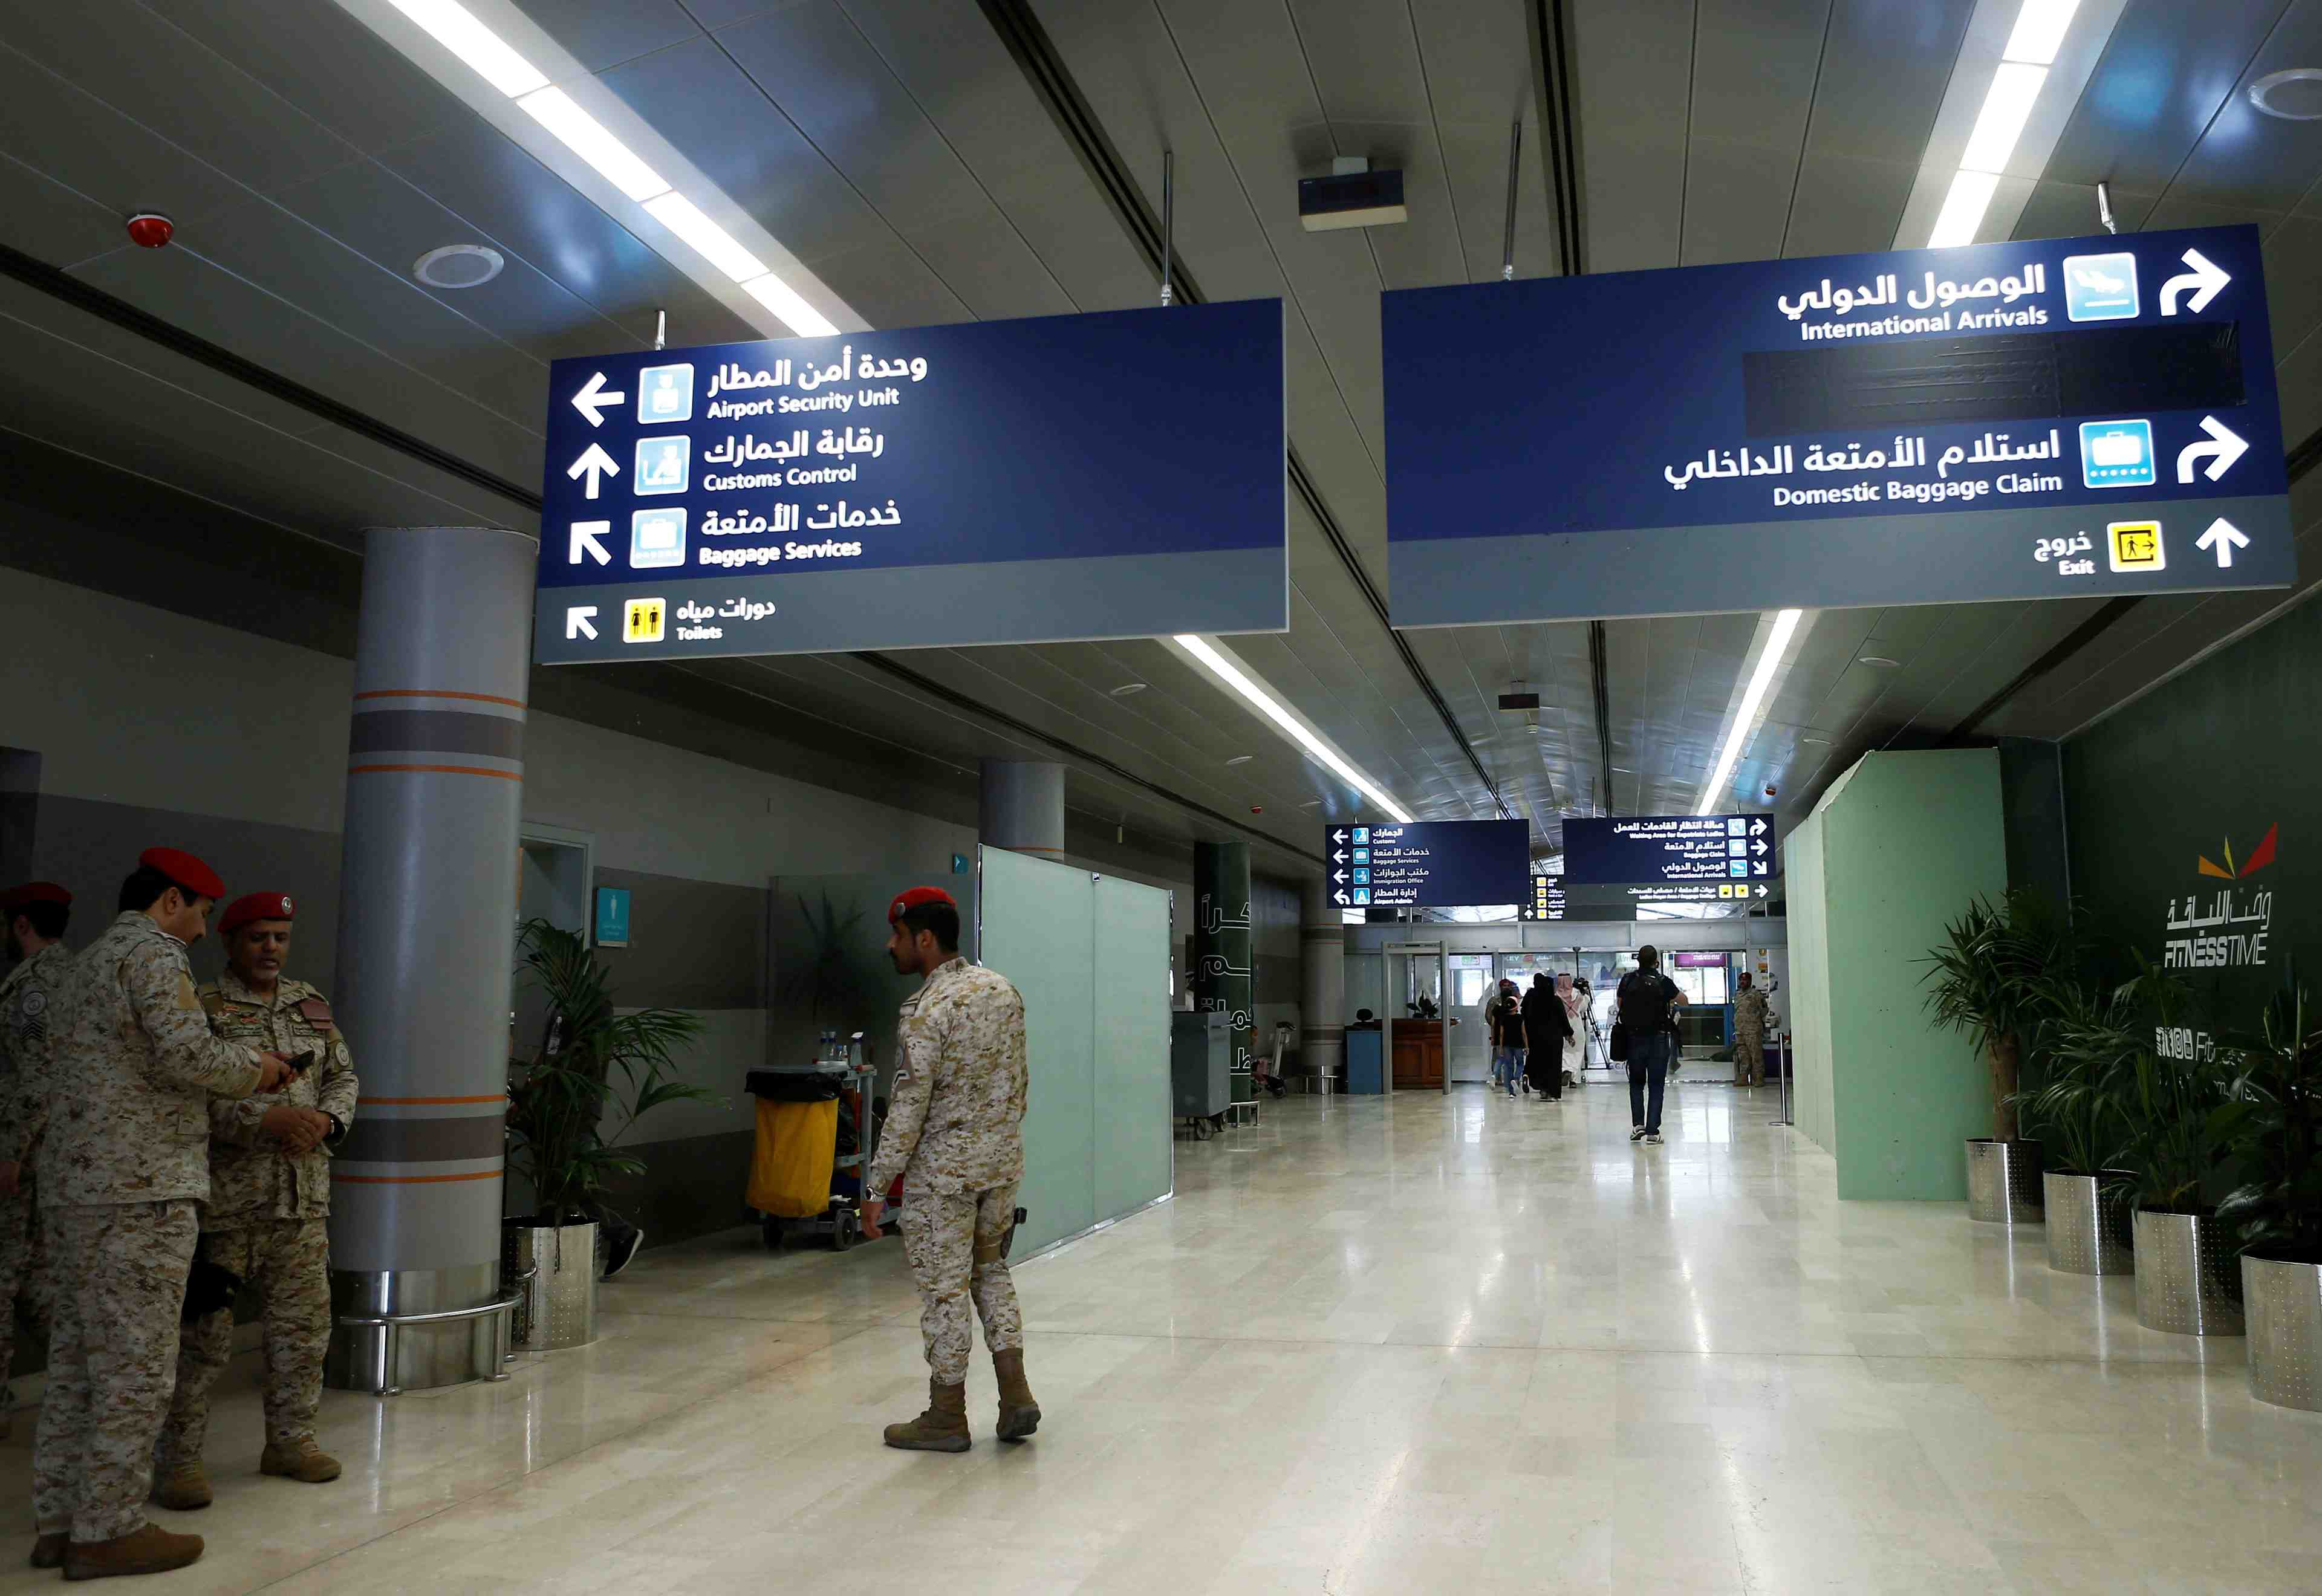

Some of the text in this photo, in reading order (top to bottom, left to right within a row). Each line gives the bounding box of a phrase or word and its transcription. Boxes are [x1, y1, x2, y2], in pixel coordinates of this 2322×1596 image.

[1778, 264, 2045, 320] الوصول الدولي
[1801, 305, 2047, 340] International Arrivals
[707, 345, 928, 398] وحدة أمن المطار
[707, 387, 900, 421] Airport Security Unit
[704, 426, 883, 468] رقابة الجمارك
[1665, 429, 2060, 490] استلام الأمتعة الداخلي
[703, 463, 856, 491] Customs Control
[1774, 473, 2062, 506] Domestic Baggage Claim
[701, 499, 901, 536] خدمات الأمتعة
[699, 539, 862, 568] Baggage Services
[2034, 531, 2092, 562] خروج
[2058, 559, 2096, 576] Exit
[677, 597, 776, 623] دورات مياه
[676, 626, 723, 640] Toilets
[1373, 828, 1403, 838] الجمارك
[1696, 841, 1725, 852] استلام
[1403, 848, 1430, 856] خدمات
[1373, 868, 1429, 878] مكتب الجوازات
[1661, 861, 1726, 873] الوصول الدولي
[1374, 888, 1399, 898] المطار
